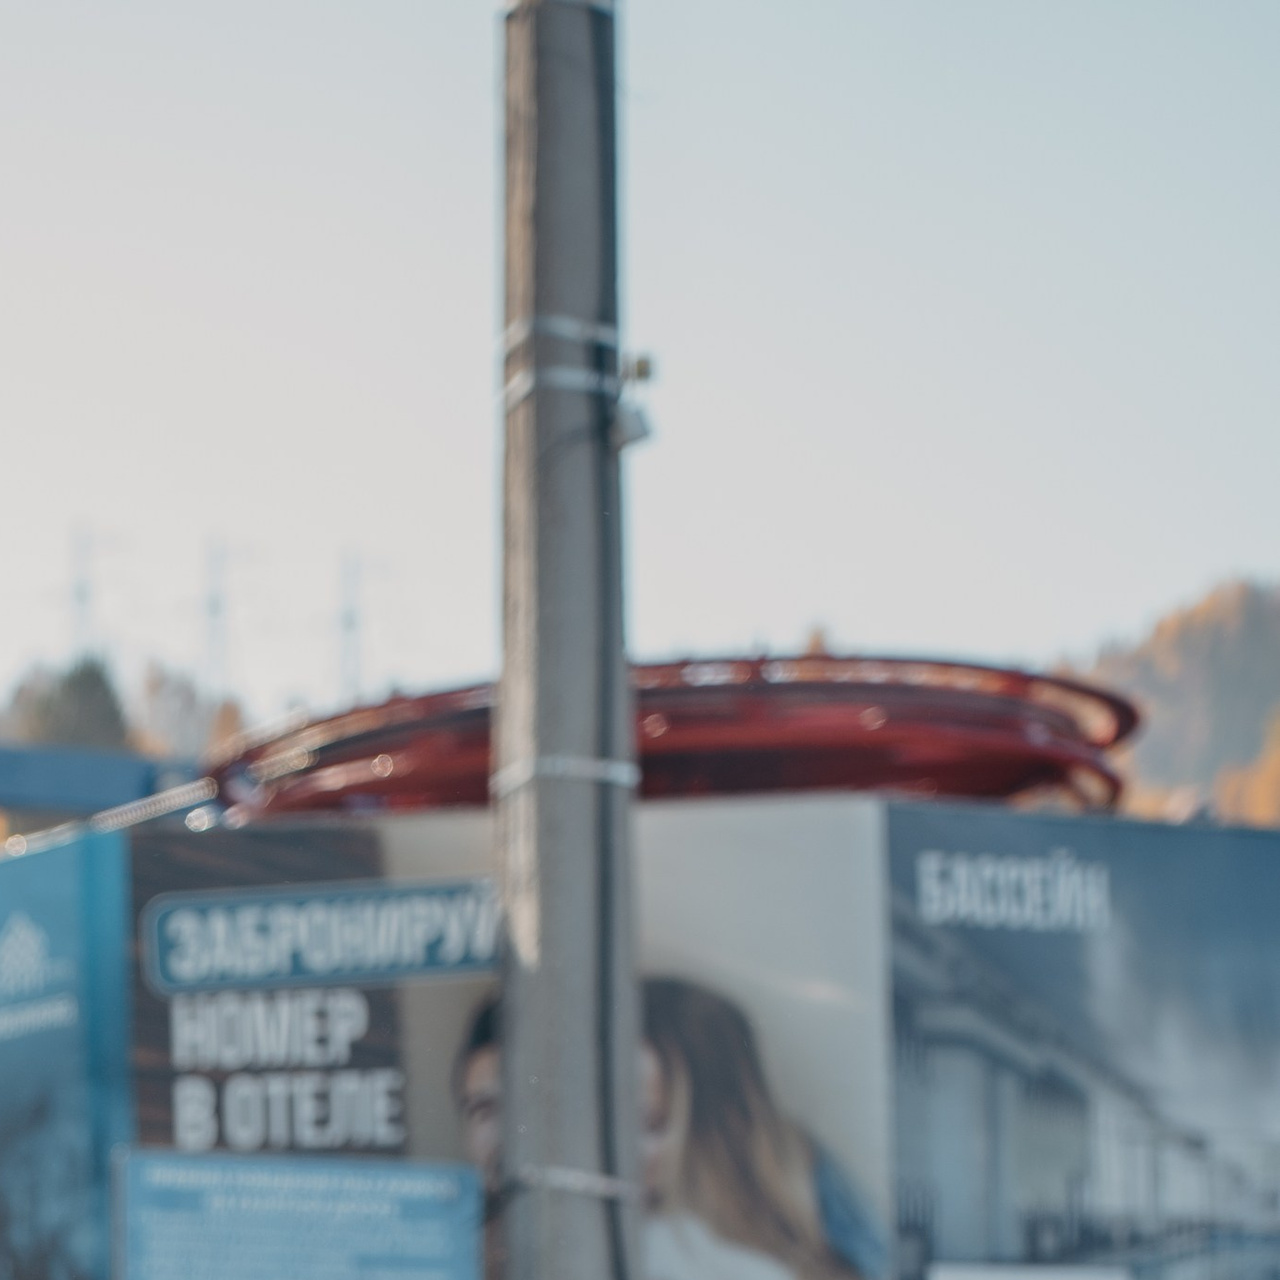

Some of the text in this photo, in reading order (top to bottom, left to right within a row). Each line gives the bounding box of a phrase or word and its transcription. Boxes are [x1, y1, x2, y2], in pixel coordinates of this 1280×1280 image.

[917, 848, 1109, 930] БАССЕЙН
[172, 990, 369, 1070] НОМЕР
[174, 1071, 403, 1150] В ОТЕЛЕ
